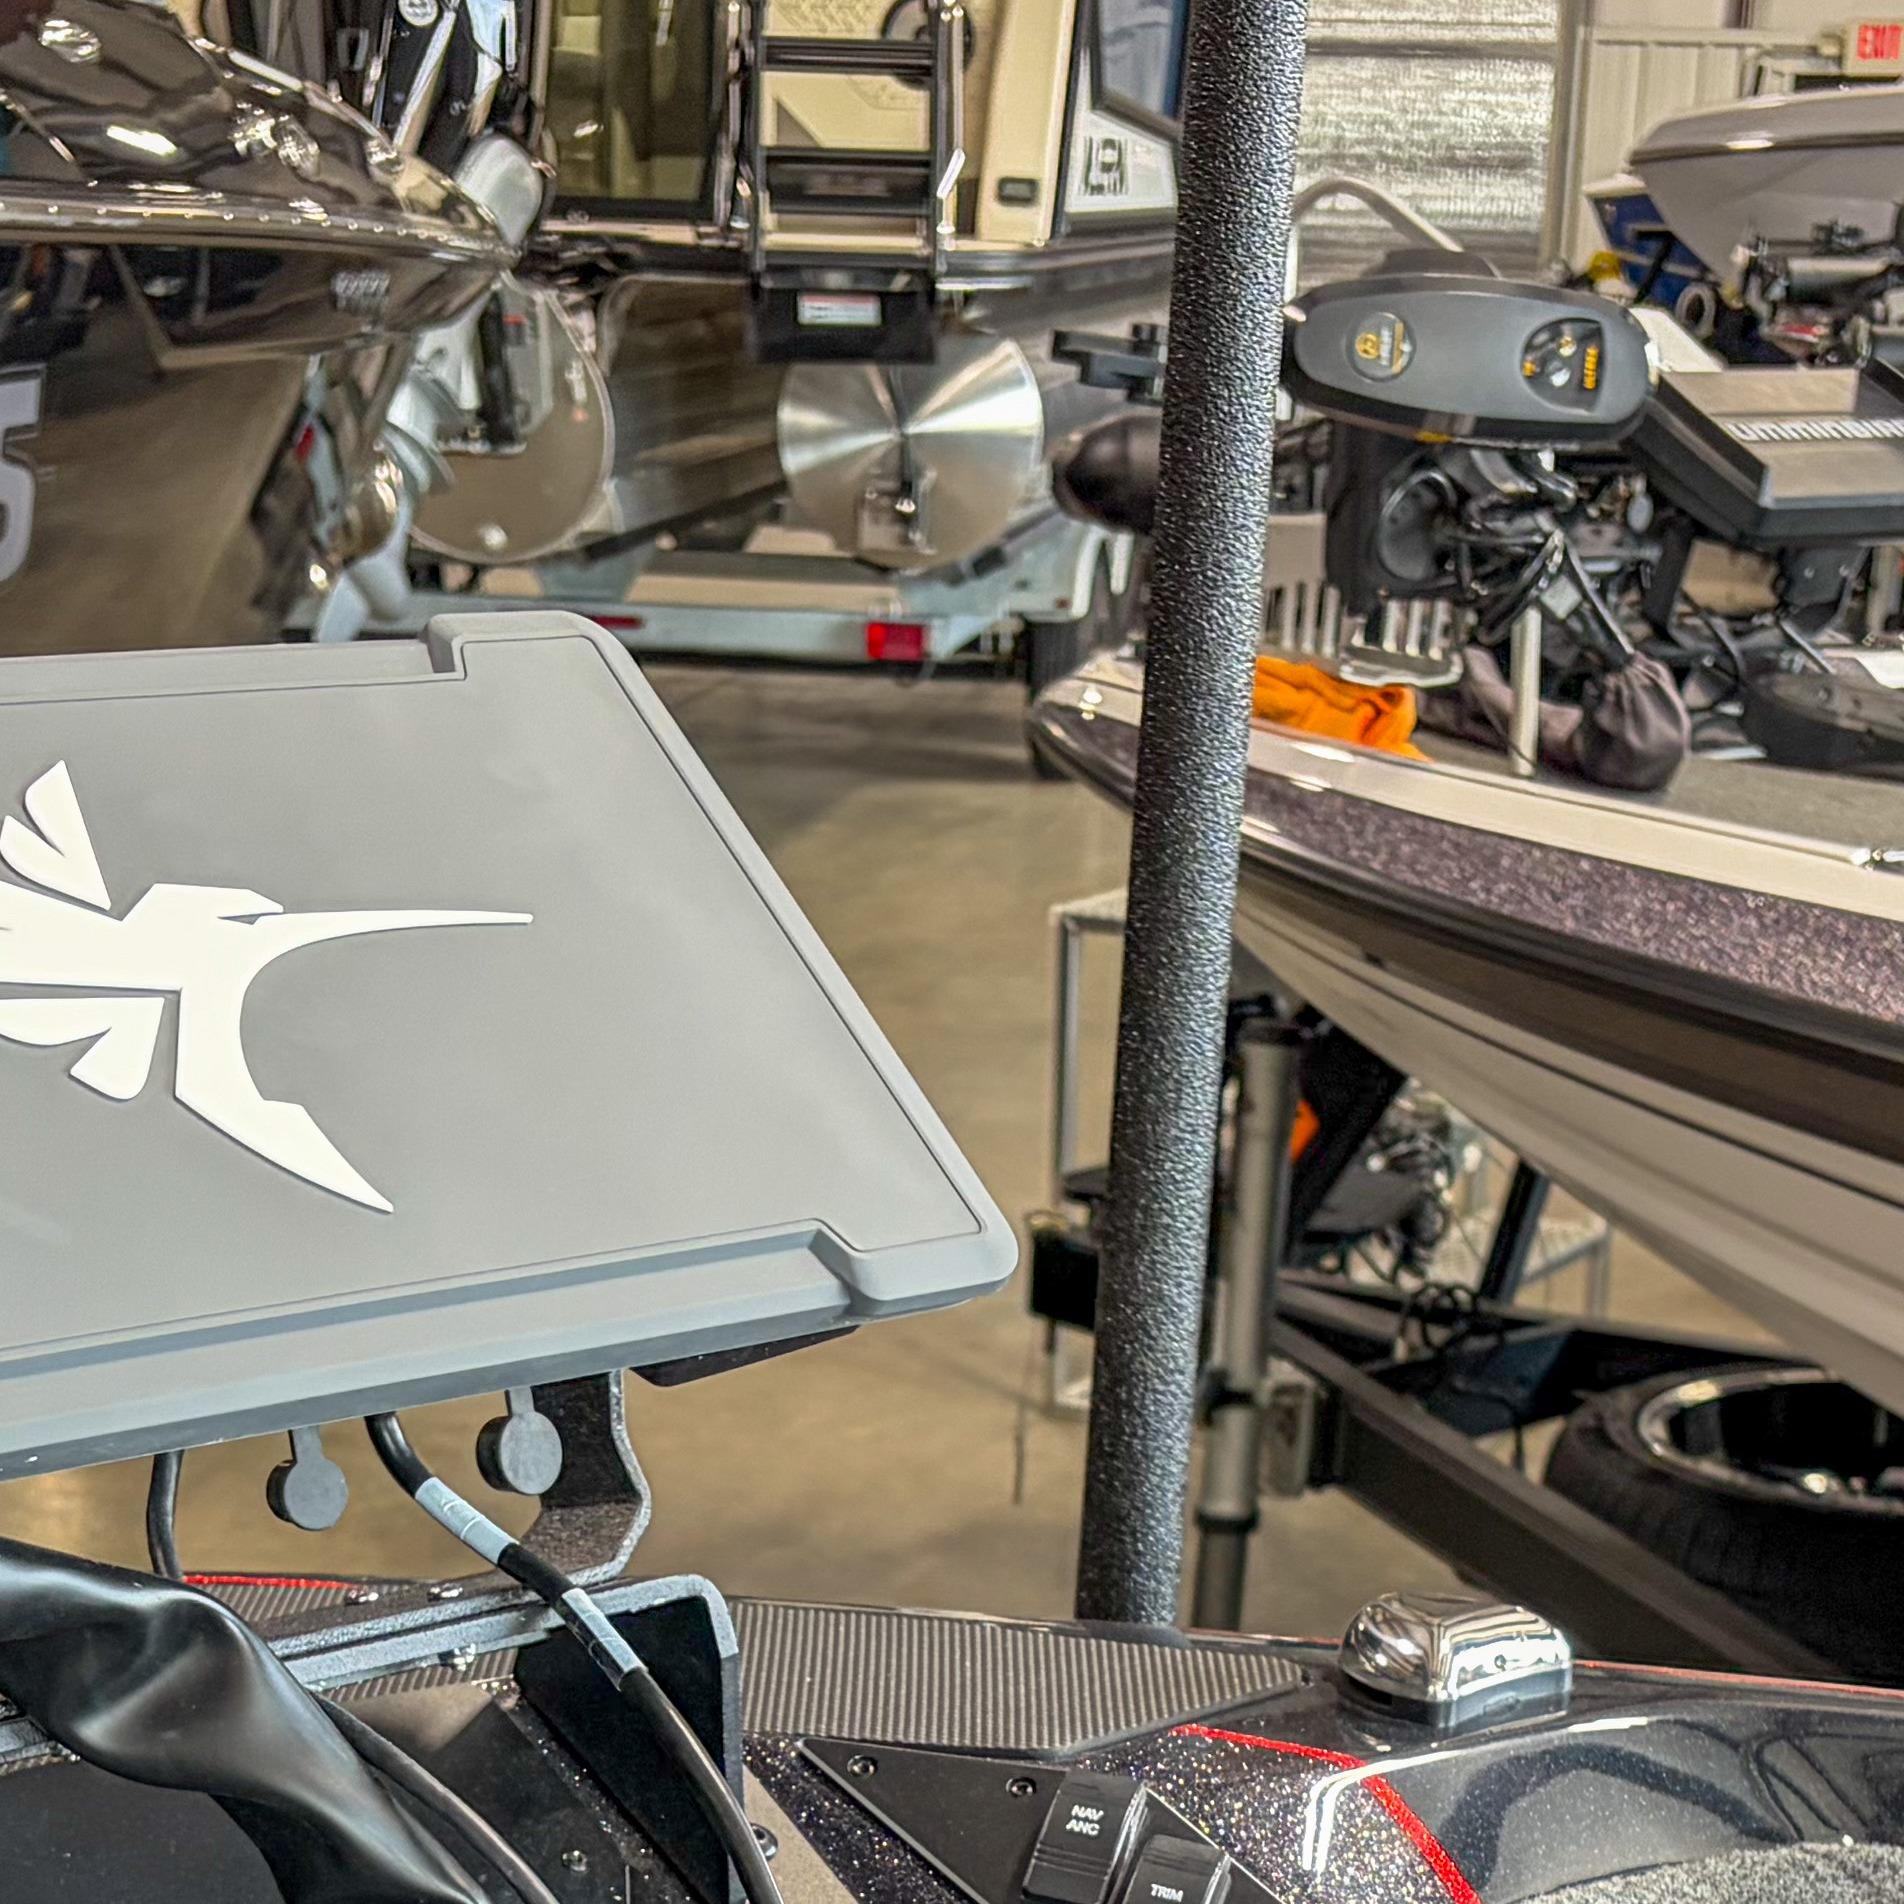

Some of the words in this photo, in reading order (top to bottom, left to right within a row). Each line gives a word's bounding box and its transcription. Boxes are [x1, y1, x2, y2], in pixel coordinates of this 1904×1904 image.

[1857, 25, 1903, 60] EXIT
[1071, 1804, 1104, 1821] NAV
[1066, 1819, 1100, 1835] ANC
[1151, 1883, 1184, 1902] TRIM
